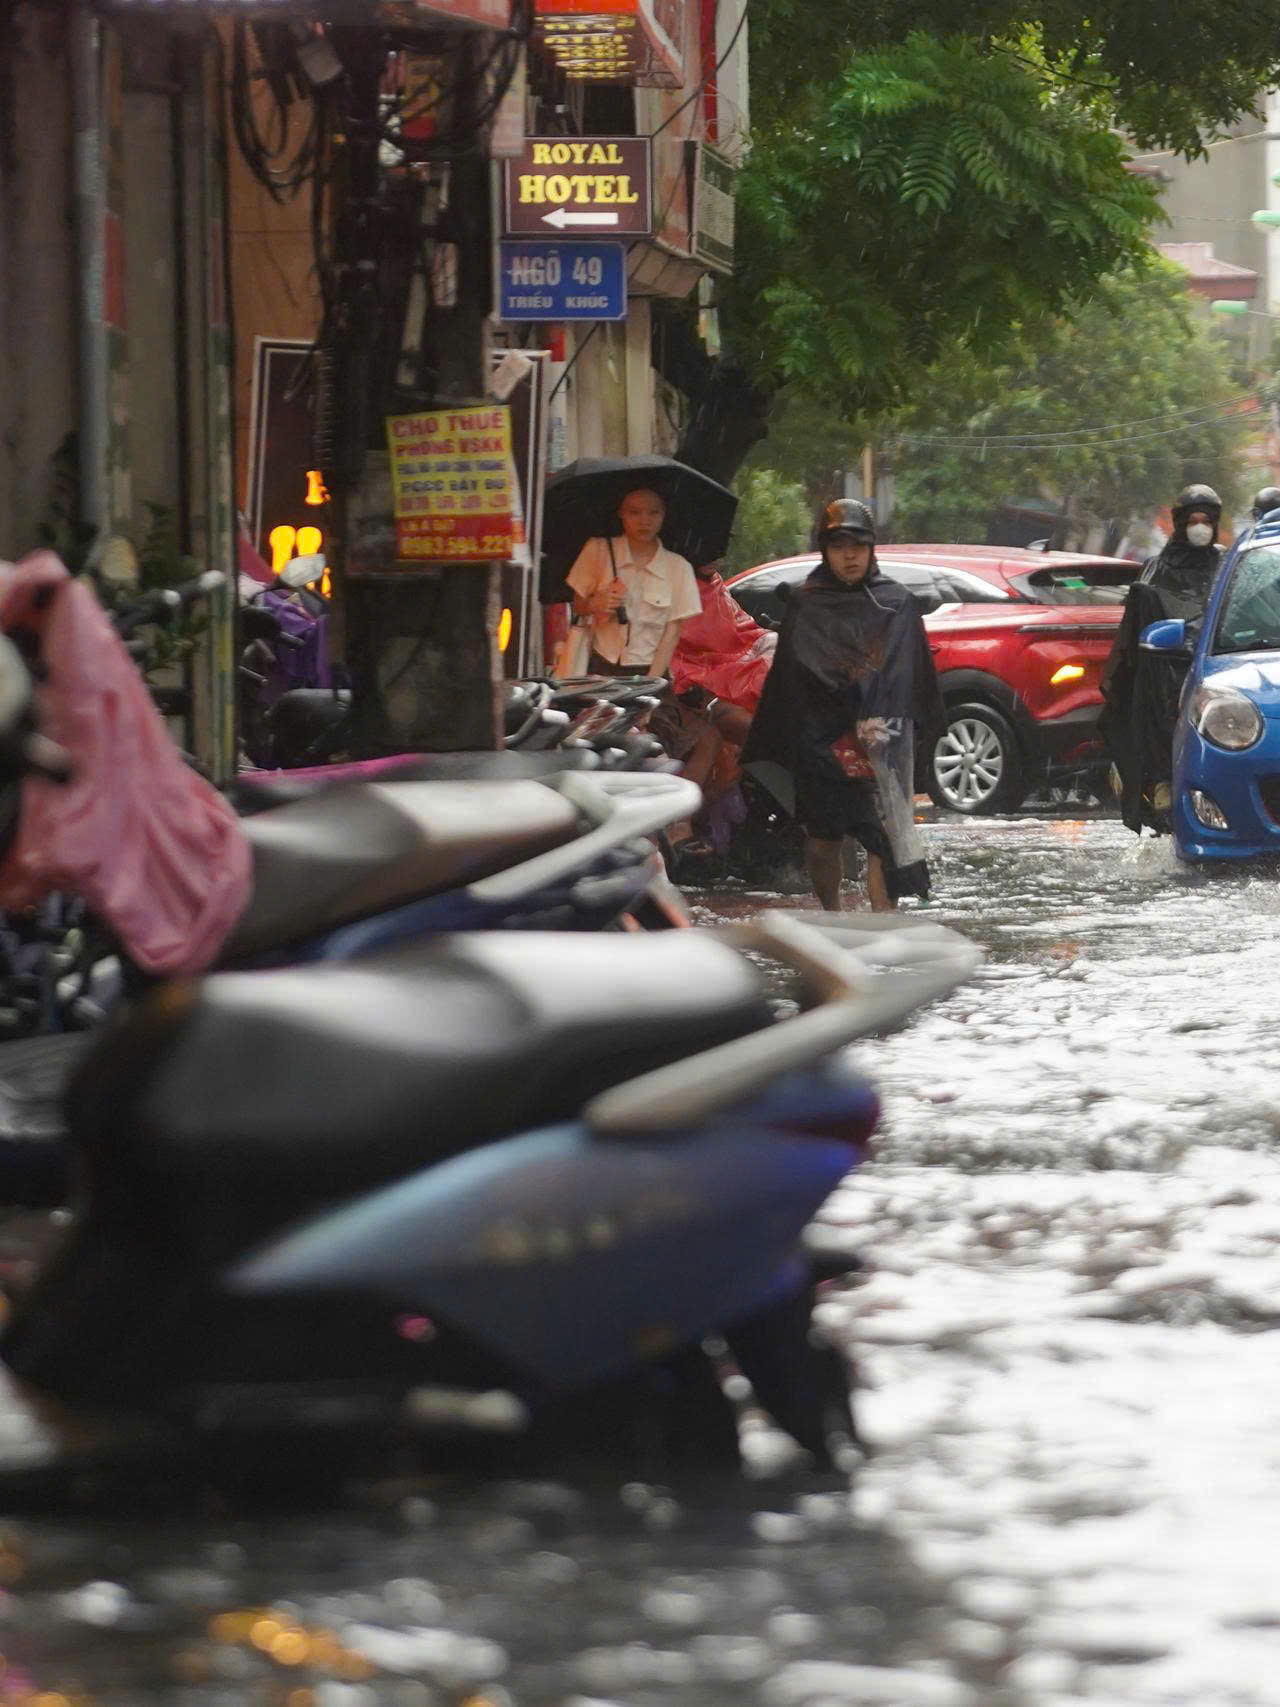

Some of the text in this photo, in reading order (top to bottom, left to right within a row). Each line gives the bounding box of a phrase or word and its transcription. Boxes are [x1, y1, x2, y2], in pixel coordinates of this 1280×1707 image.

[532, 143, 624, 165] ROYAL
[518, 175, 639, 204] HOTEL
[510, 250, 603, 286] NGÕ 49
[565, 292, 609, 309] KHÚC
[392, 417, 439, 437] CHO
